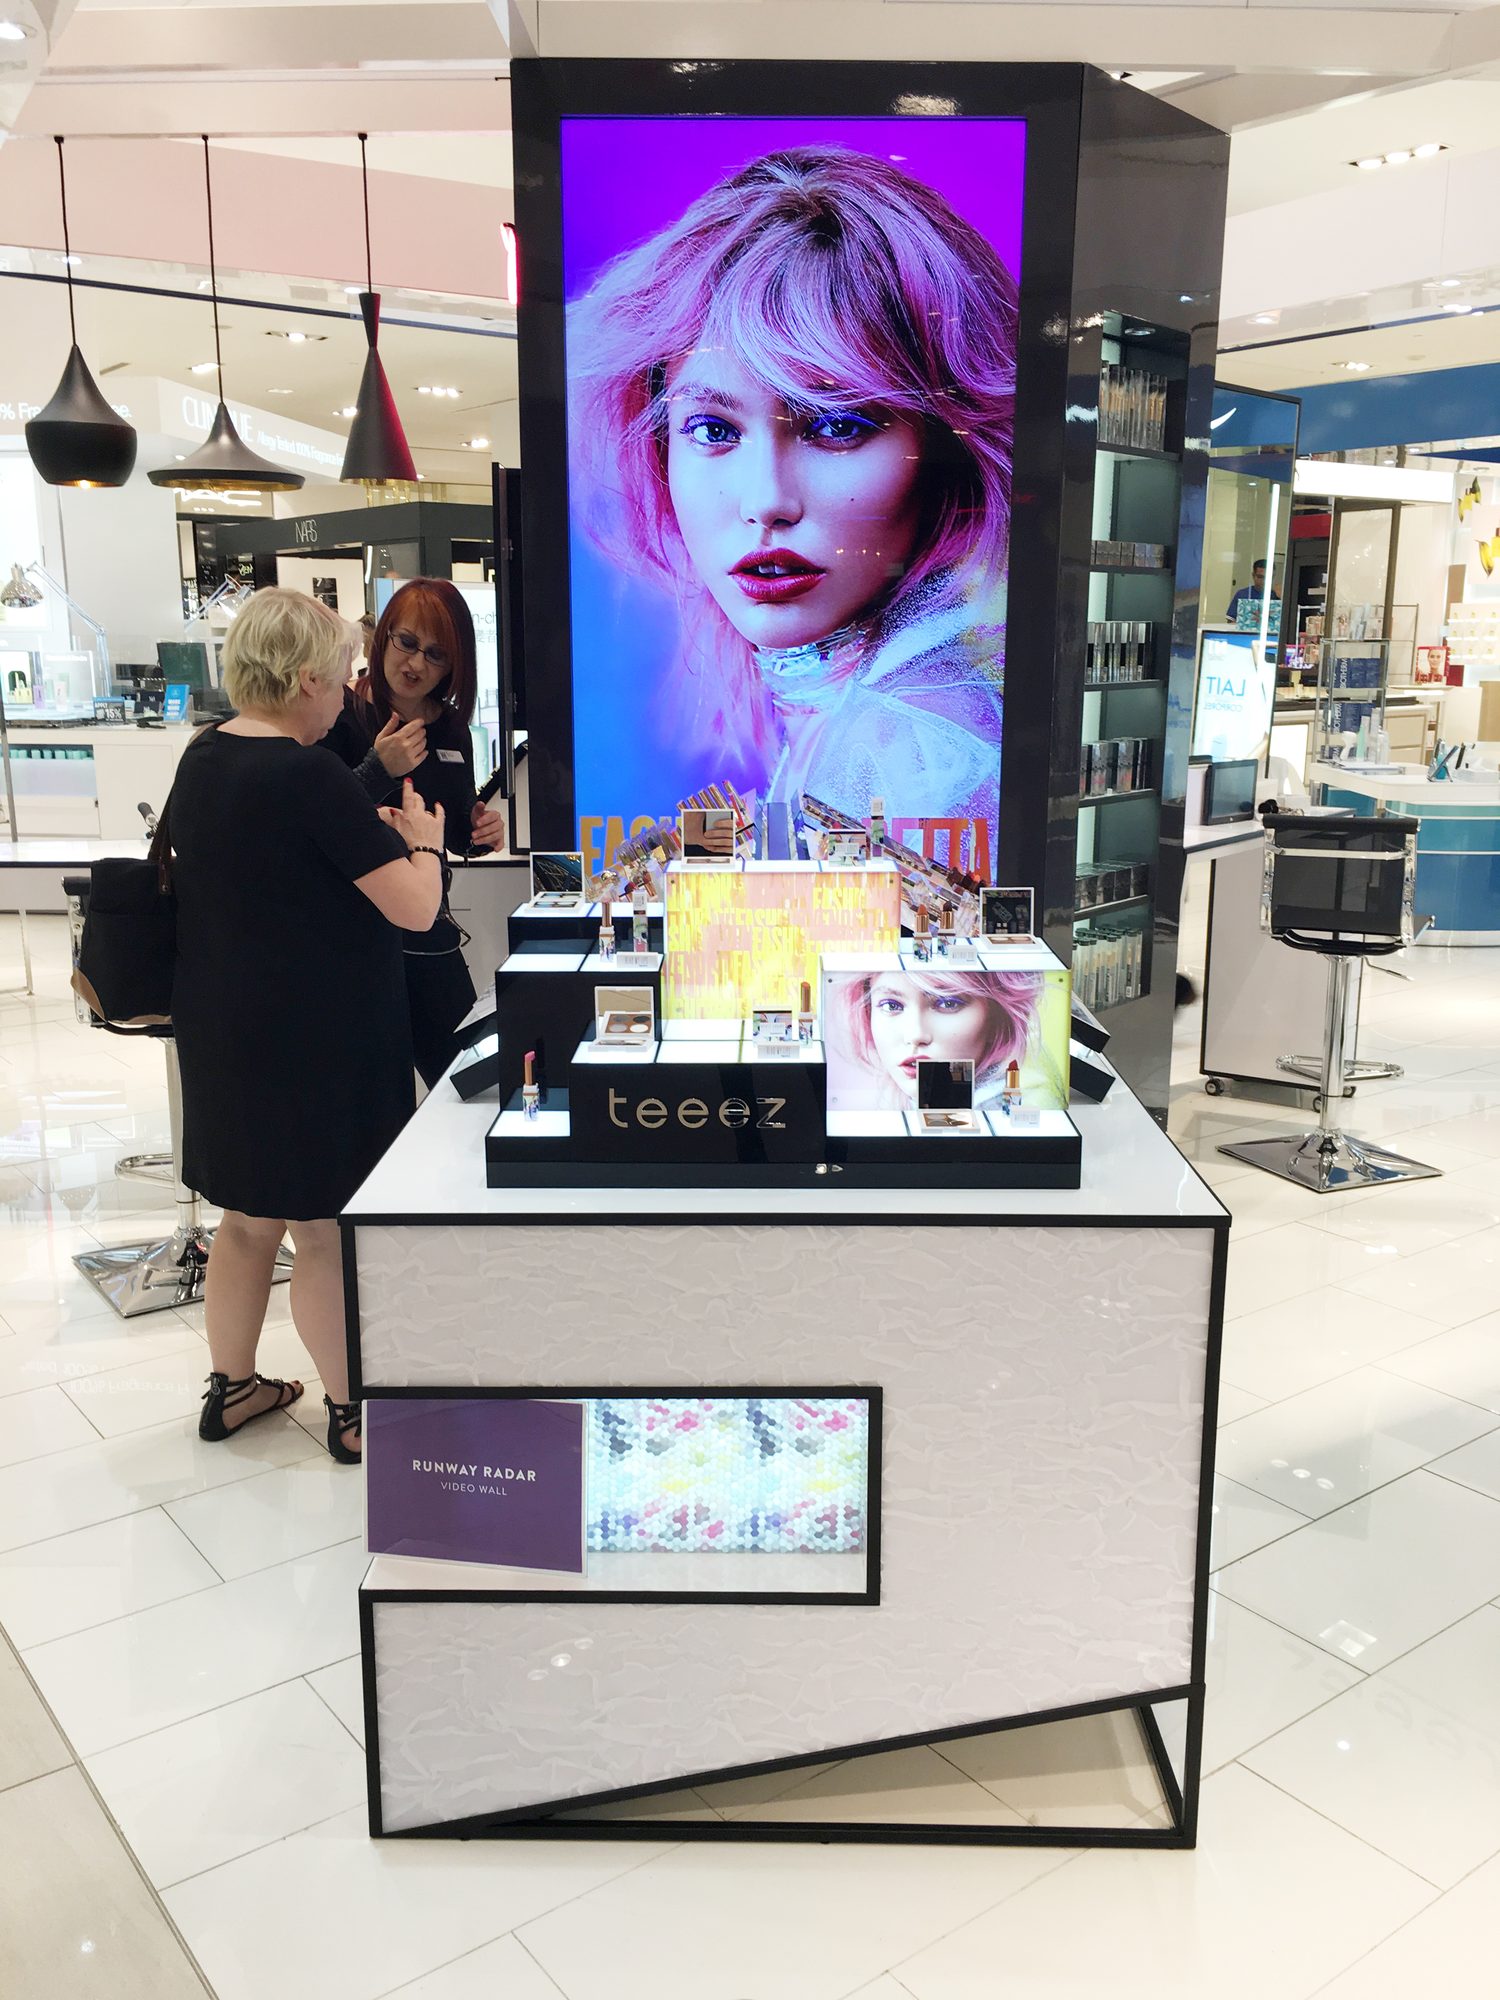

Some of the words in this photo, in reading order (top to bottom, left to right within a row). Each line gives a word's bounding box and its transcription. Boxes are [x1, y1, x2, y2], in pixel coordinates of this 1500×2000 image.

[295, 519, 318, 543] NARS
[608, 1087, 786, 1129] teeez
[412, 1459, 478, 1477] RUNWAY
[483, 1466, 537, 1482] RADAR
[440, 1481, 476, 1493] VIDEO
[478, 1485, 508, 1496] WALL
